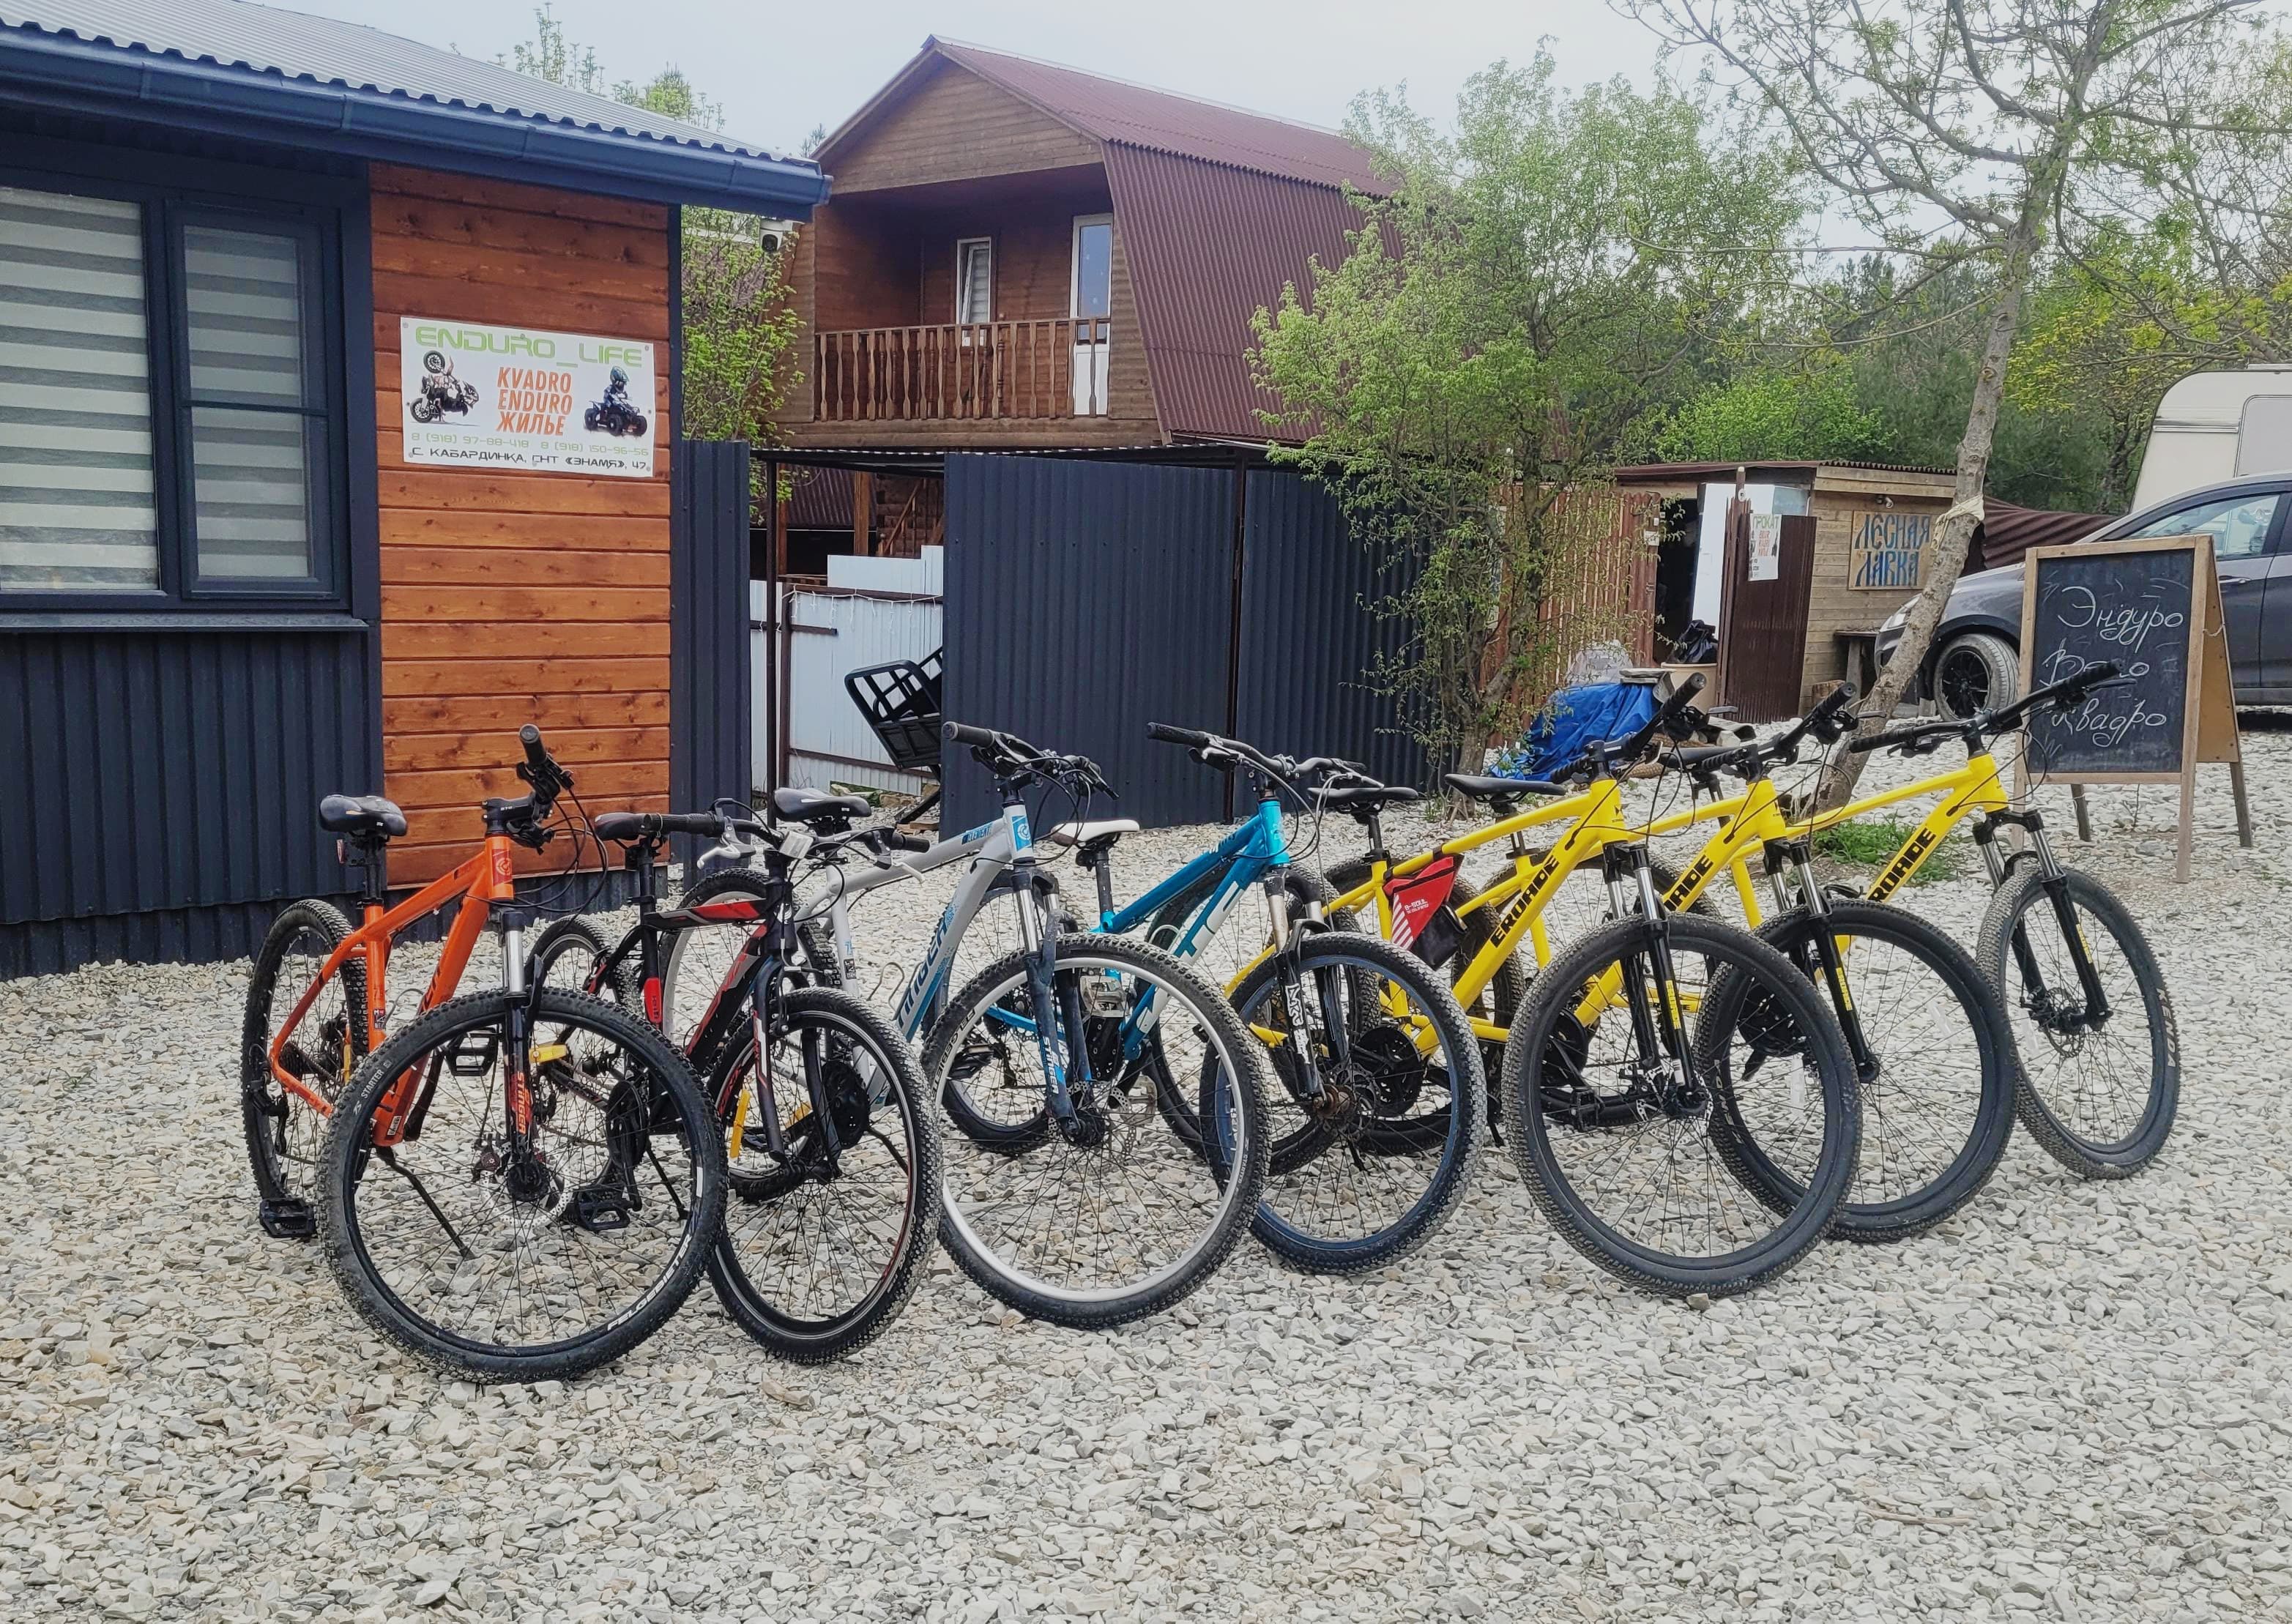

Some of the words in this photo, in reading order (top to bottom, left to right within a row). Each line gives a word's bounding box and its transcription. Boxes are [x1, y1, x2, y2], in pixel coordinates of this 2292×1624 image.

[415, 327, 642, 367] ENDURO_LIFE
[497, 367, 571, 394] KVADRO
[498, 389, 573, 415] ENDURO
[496, 411, 566, 436] ЖИЛЬЕ
[430, 448, 527, 463] КАБАРДИНКА,
[532, 455, 559, 464] СНТ
[540, 442, 549, 450] 8
[1753, 515, 1779, 529] ПРОКАТ
[1854, 514, 1930, 549] ЛЕСНАЯ
[1855, 551, 1919, 586] ЛАВКА
[2058, 586, 2184, 653] Эндуро
[2039, 638, 2149, 687] Во
[1867, 827, 1936, 903] ROADE
[898, 917, 948, 1029] TINGER
[2156, 988, 2176, 1067] KENDA
[361, 1069, 384, 1098] STARTER
[608, 1234, 692, 1331] FELGEBIETER
